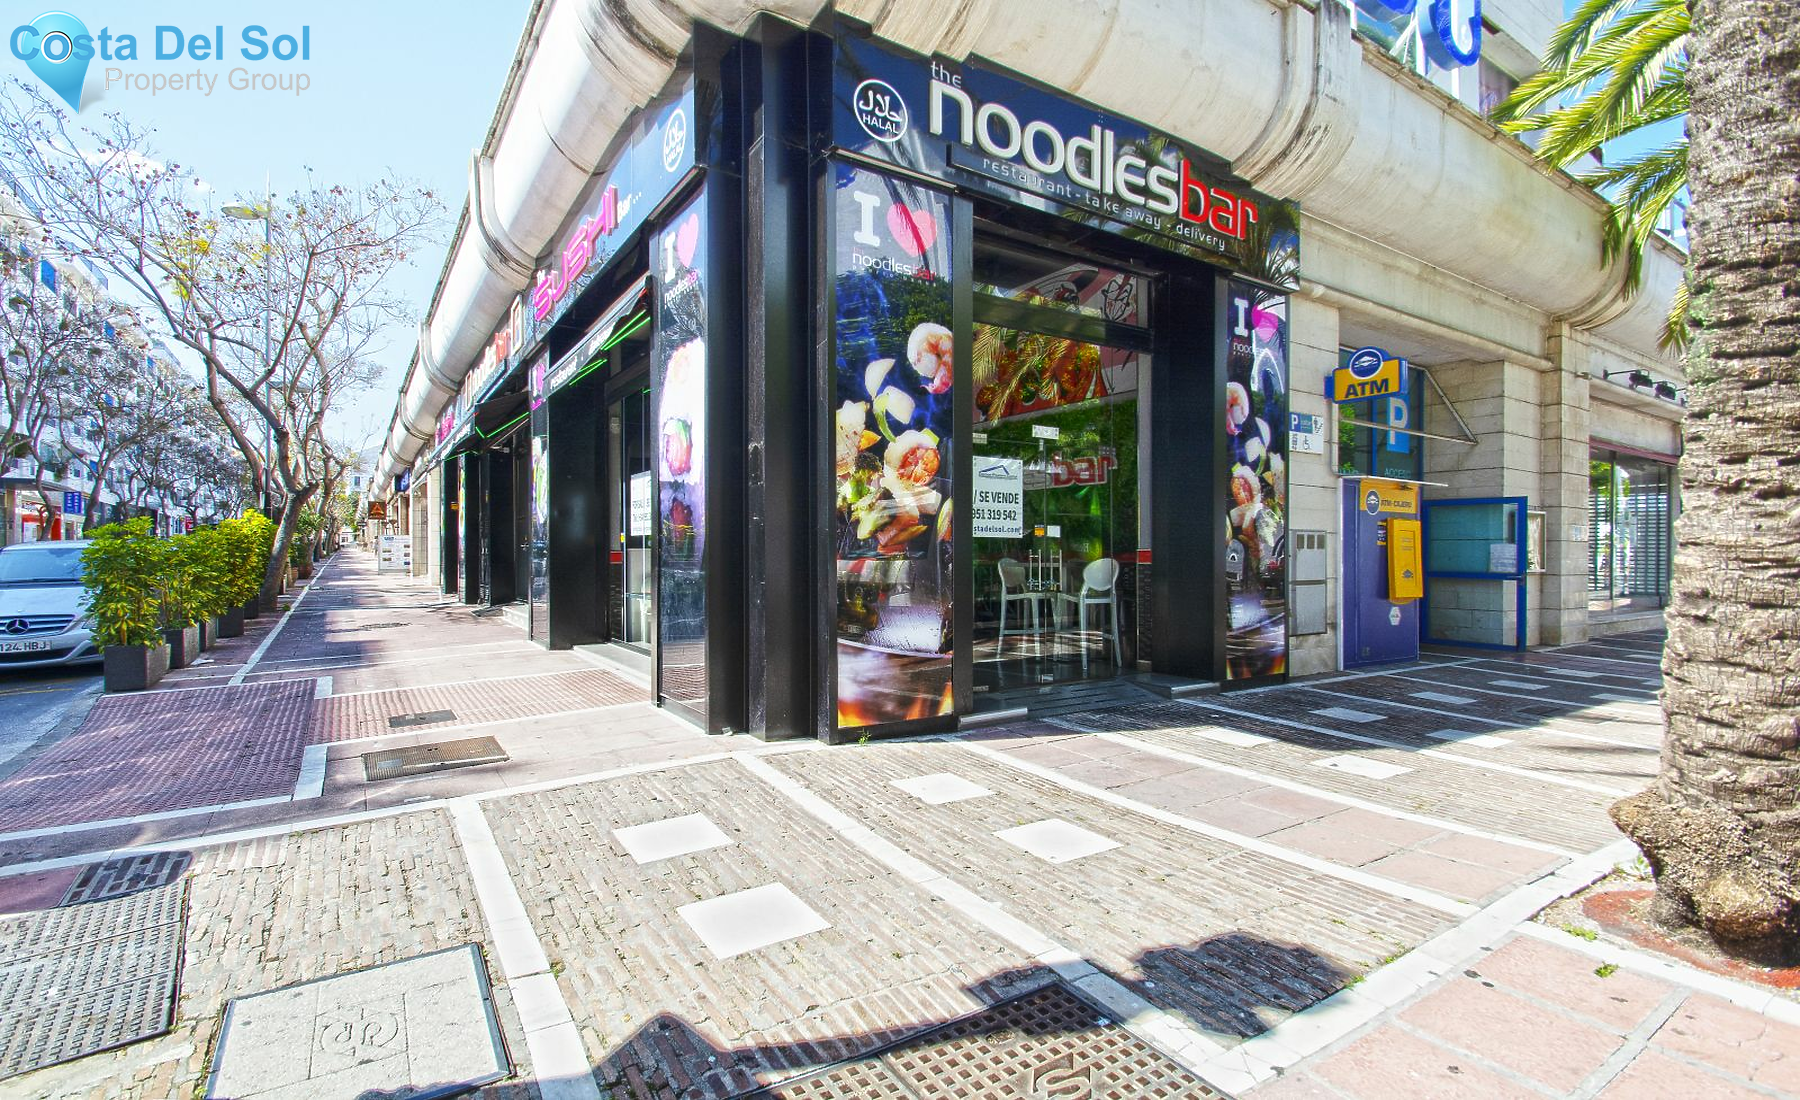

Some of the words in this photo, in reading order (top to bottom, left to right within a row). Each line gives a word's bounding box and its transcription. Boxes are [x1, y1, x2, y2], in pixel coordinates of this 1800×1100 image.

[930, 61, 962, 88] the
[862, 113, 900, 134] HALAL
[983, 158, 1073, 199] restaurant
[1085, 187, 1120, 214] take
[1125, 207, 1161, 230] away
[1176, 222, 1226, 251] delivery
[853, 190, 881, 247] I
[1234, 297, 1249, 338] I
[1344, 378, 1390, 398] ATM
[1291, 413, 1299, 430] P
[1390, 397, 1408, 445] P
[978, 491, 990, 503] SE
[991, 492, 1020, 505] VENDE
[987, 509, 1002, 521] 319
[1003, 510, 1017, 522] 542
